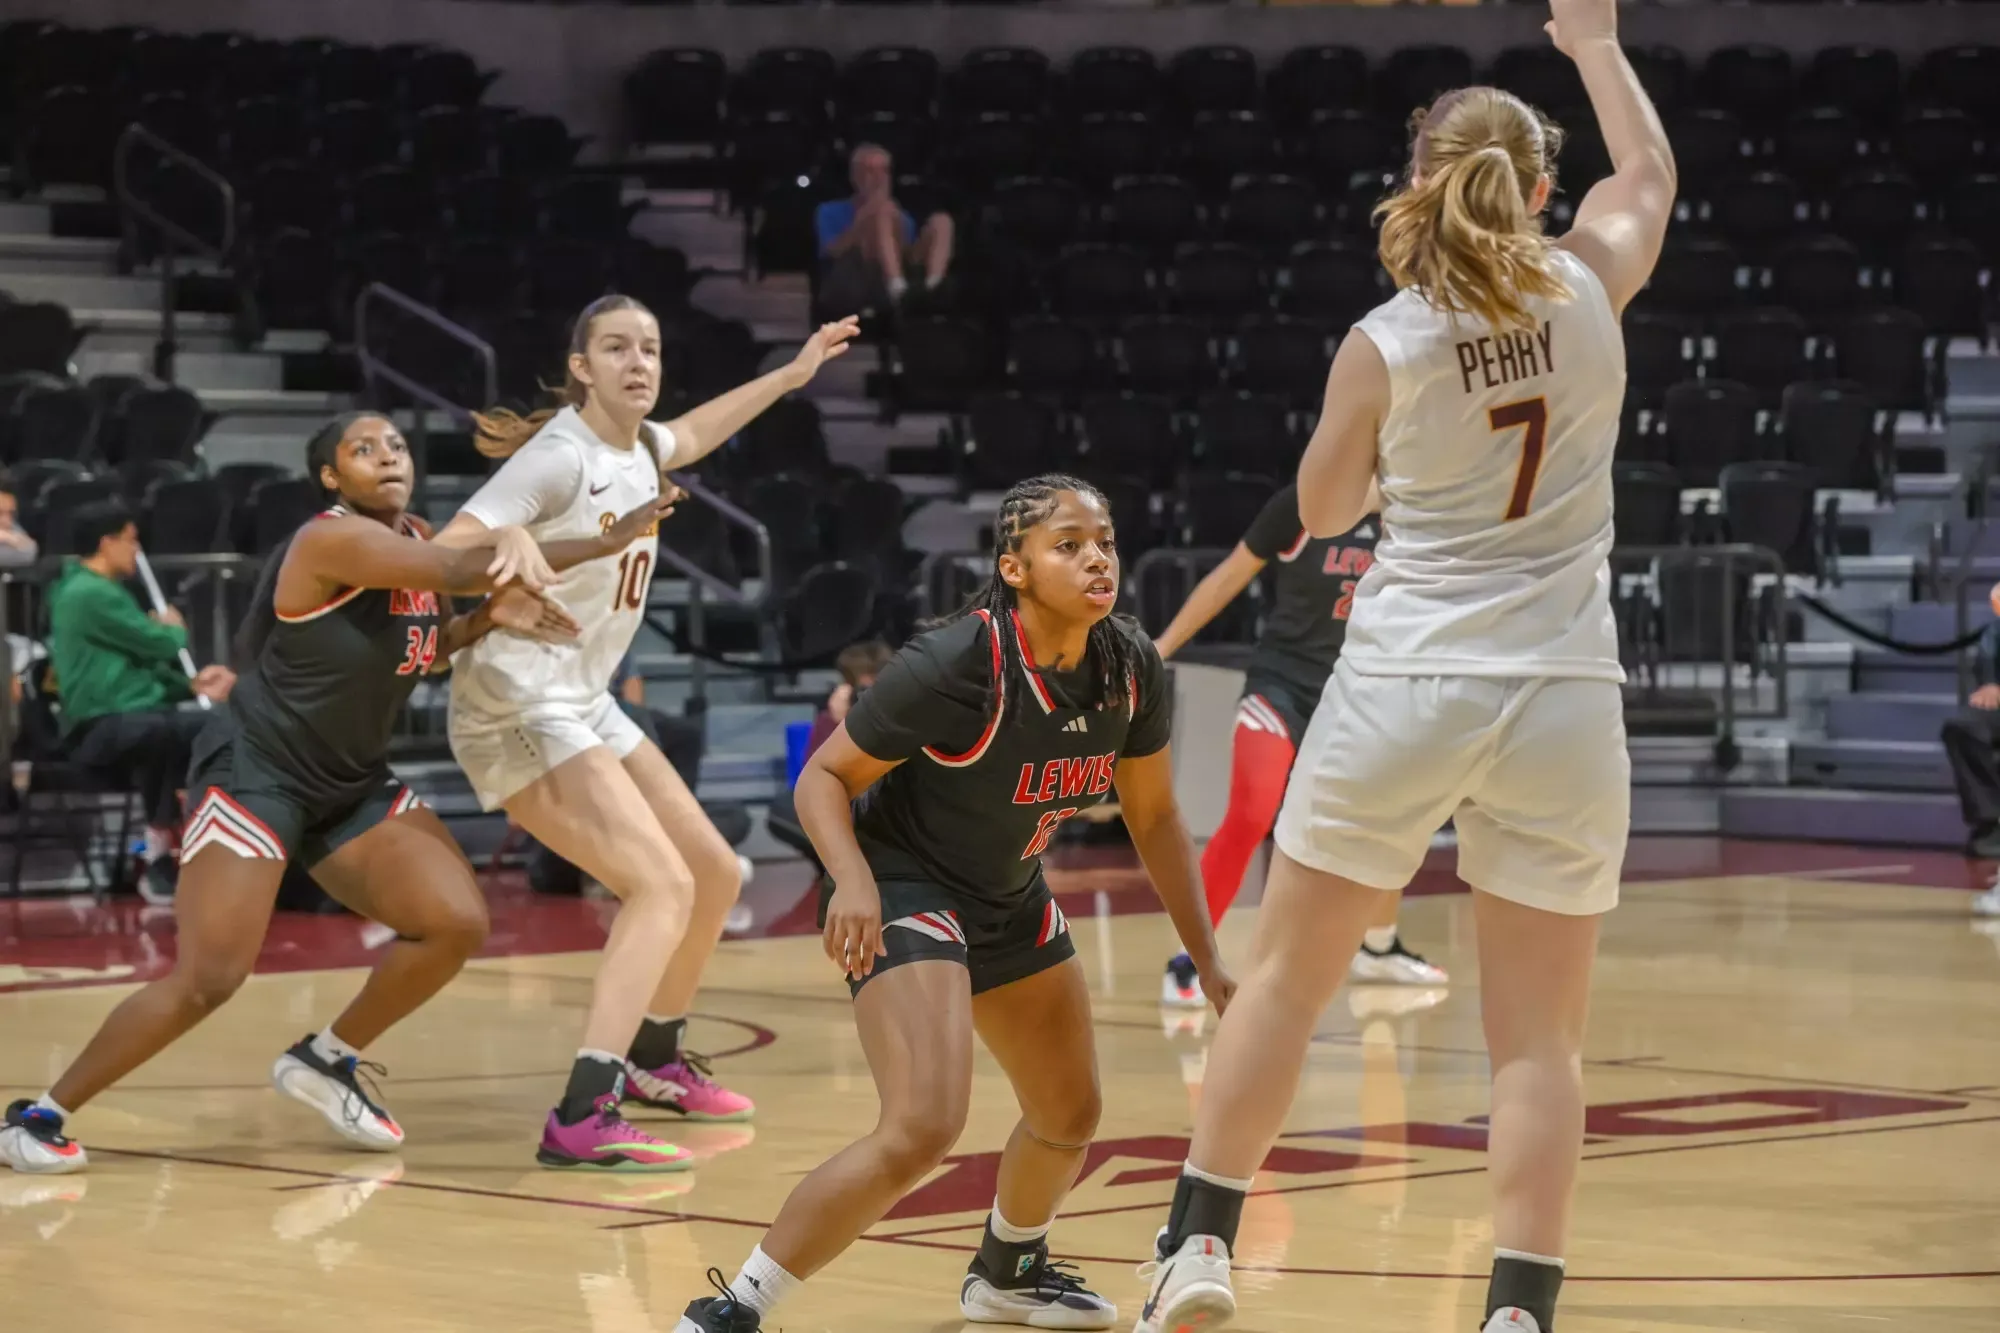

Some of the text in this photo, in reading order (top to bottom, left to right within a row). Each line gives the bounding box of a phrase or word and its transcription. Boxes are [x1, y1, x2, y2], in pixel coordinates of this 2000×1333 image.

[1456, 321, 1554, 393] PERRY
[1488, 395, 1548, 522] 7
[614, 550, 650, 613] 10
[396, 625, 438, 675] 34
[1012, 750, 1116, 804] LEWIS
